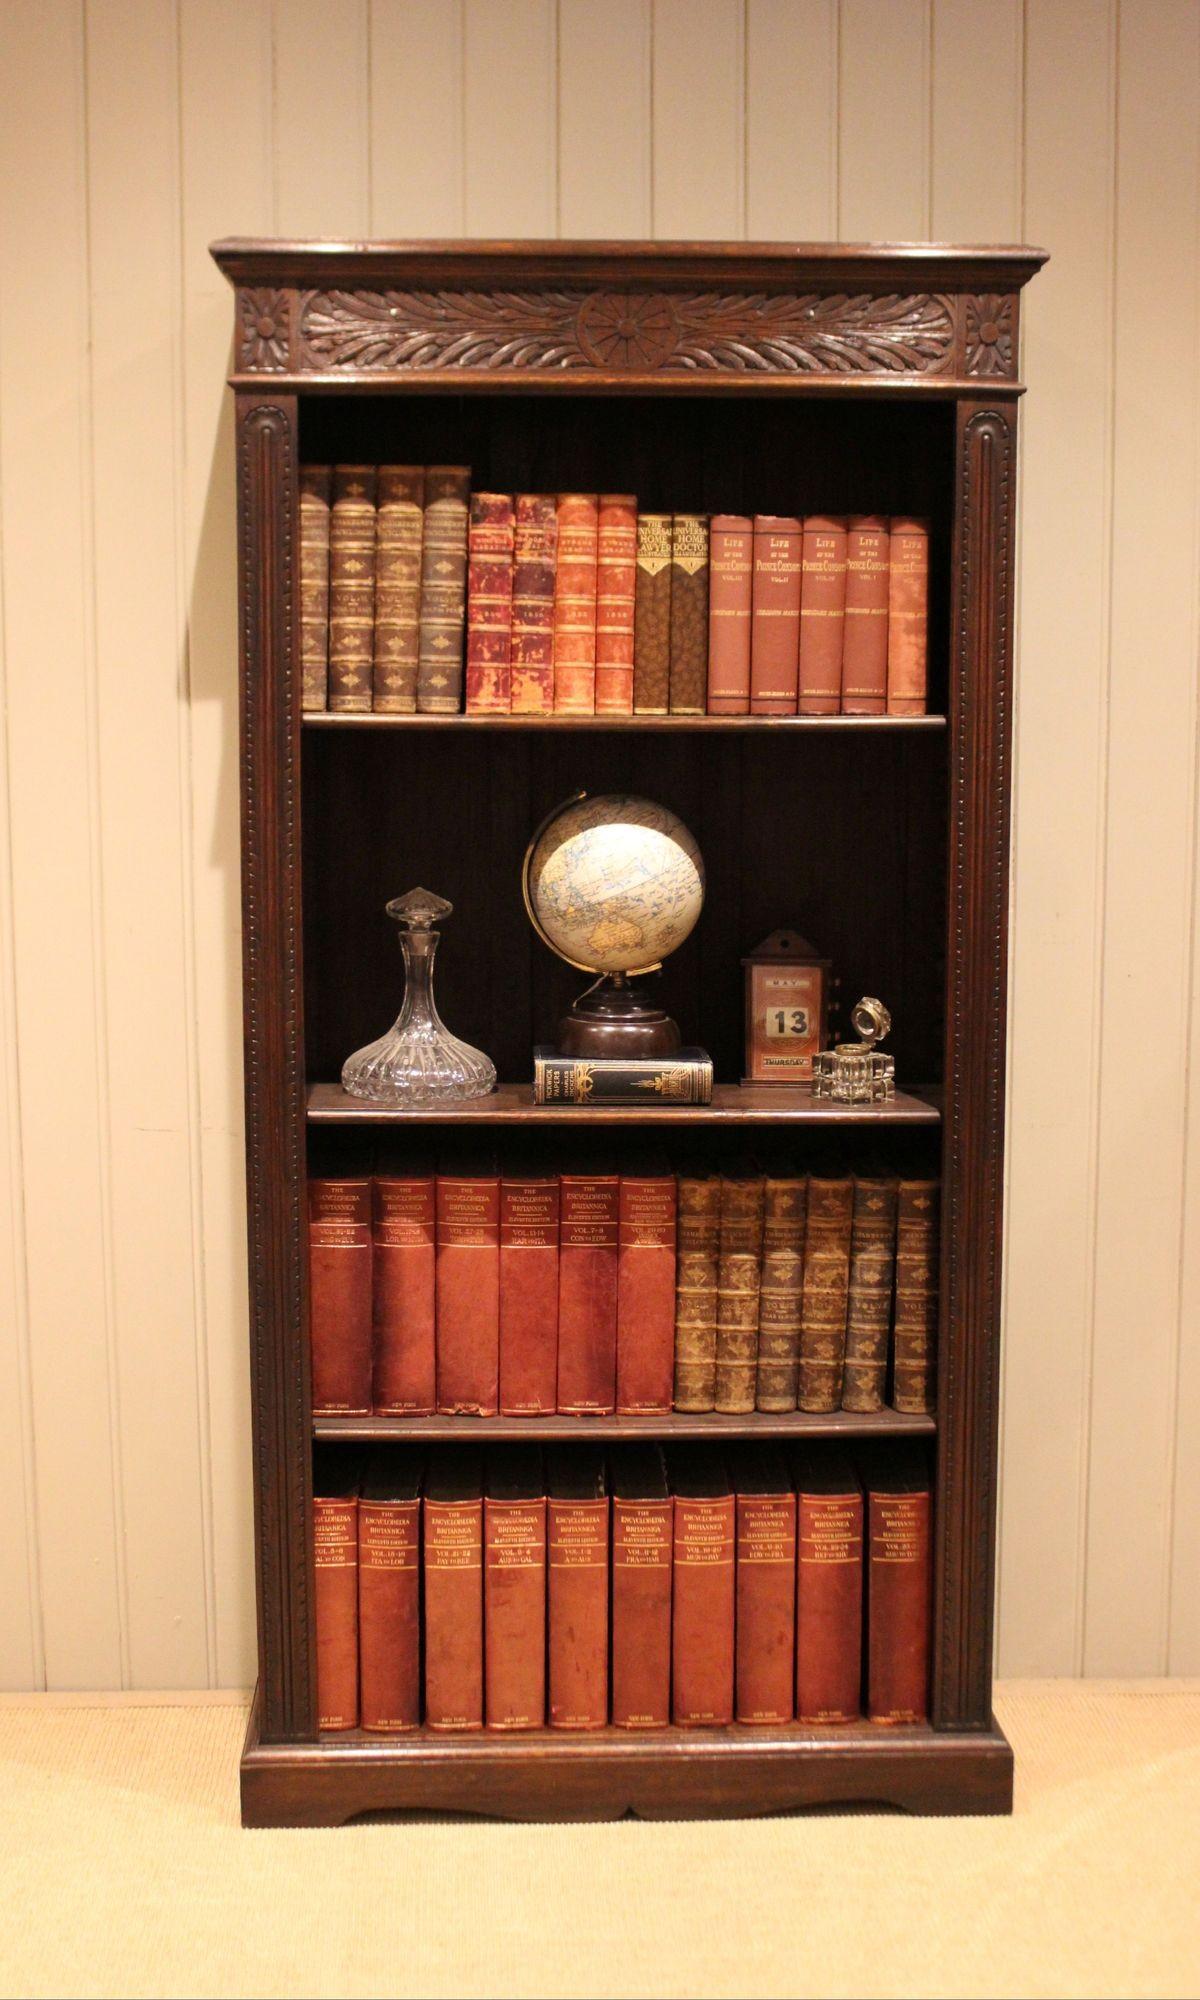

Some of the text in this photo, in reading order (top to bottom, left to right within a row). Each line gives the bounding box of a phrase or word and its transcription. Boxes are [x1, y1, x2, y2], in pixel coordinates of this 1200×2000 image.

[648, 520, 663, 528] THE
[639, 528, 672, 536] NIVERSAL
[640, 535, 667, 543] HOME
[679, 535, 705, 543] HOME
[640, 544, 671, 552] AWYER
[774, 1010, 808, 1034] 13
[370, 1527, 405, 1535] BRITANNICA
